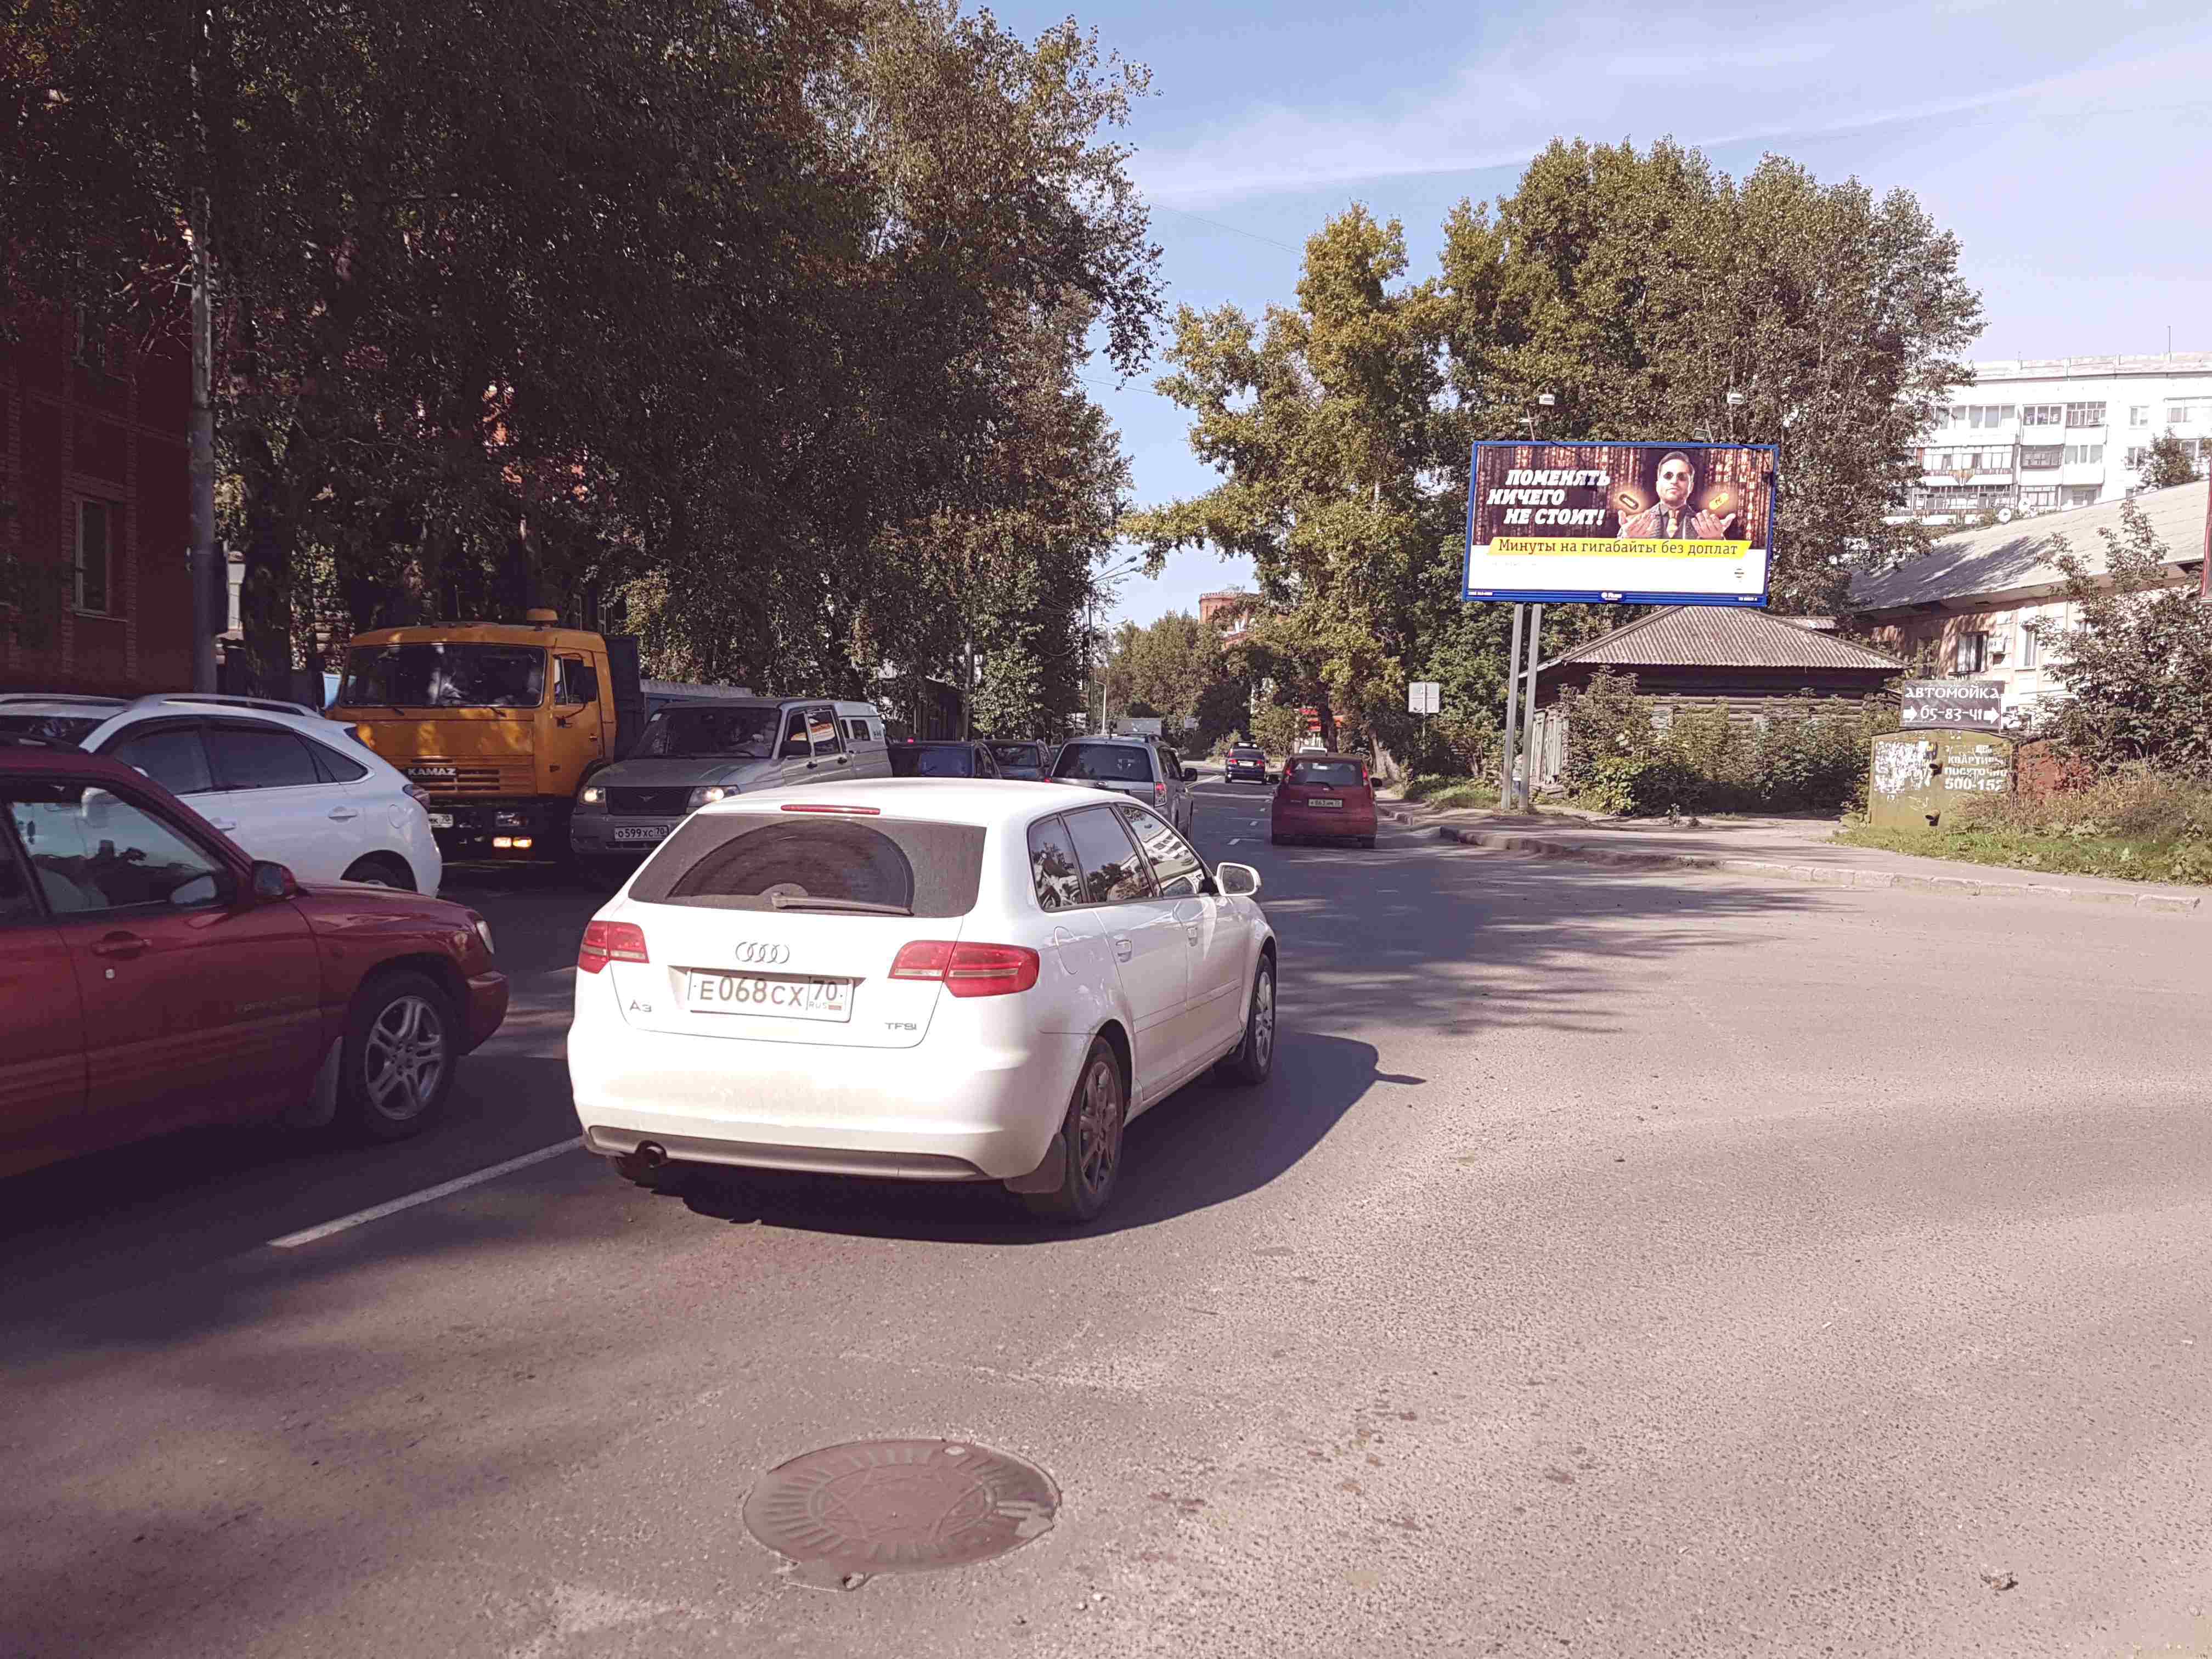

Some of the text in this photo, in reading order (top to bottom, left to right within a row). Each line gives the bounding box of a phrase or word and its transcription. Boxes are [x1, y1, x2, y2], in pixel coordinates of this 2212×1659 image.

[1505, 470, 1611, 486] ПОМЕНЯТЬ
[1486, 489, 1565, 505] НИЧЕГО
[1503, 509, 1605, 526] НЕ СТОИТ!
[1499, 539, 1738, 556] Минуты на гигабайты без доплат
[1920, 704, 1983, 721] 65-83-41
[408, 768, 456, 776] KAMAZ
[812, 980, 838, 1001] 70
[629, 999, 652, 1013] A3
[809, 1001, 827, 1009] RUS
[884, 1023, 917, 1031] TFSI
